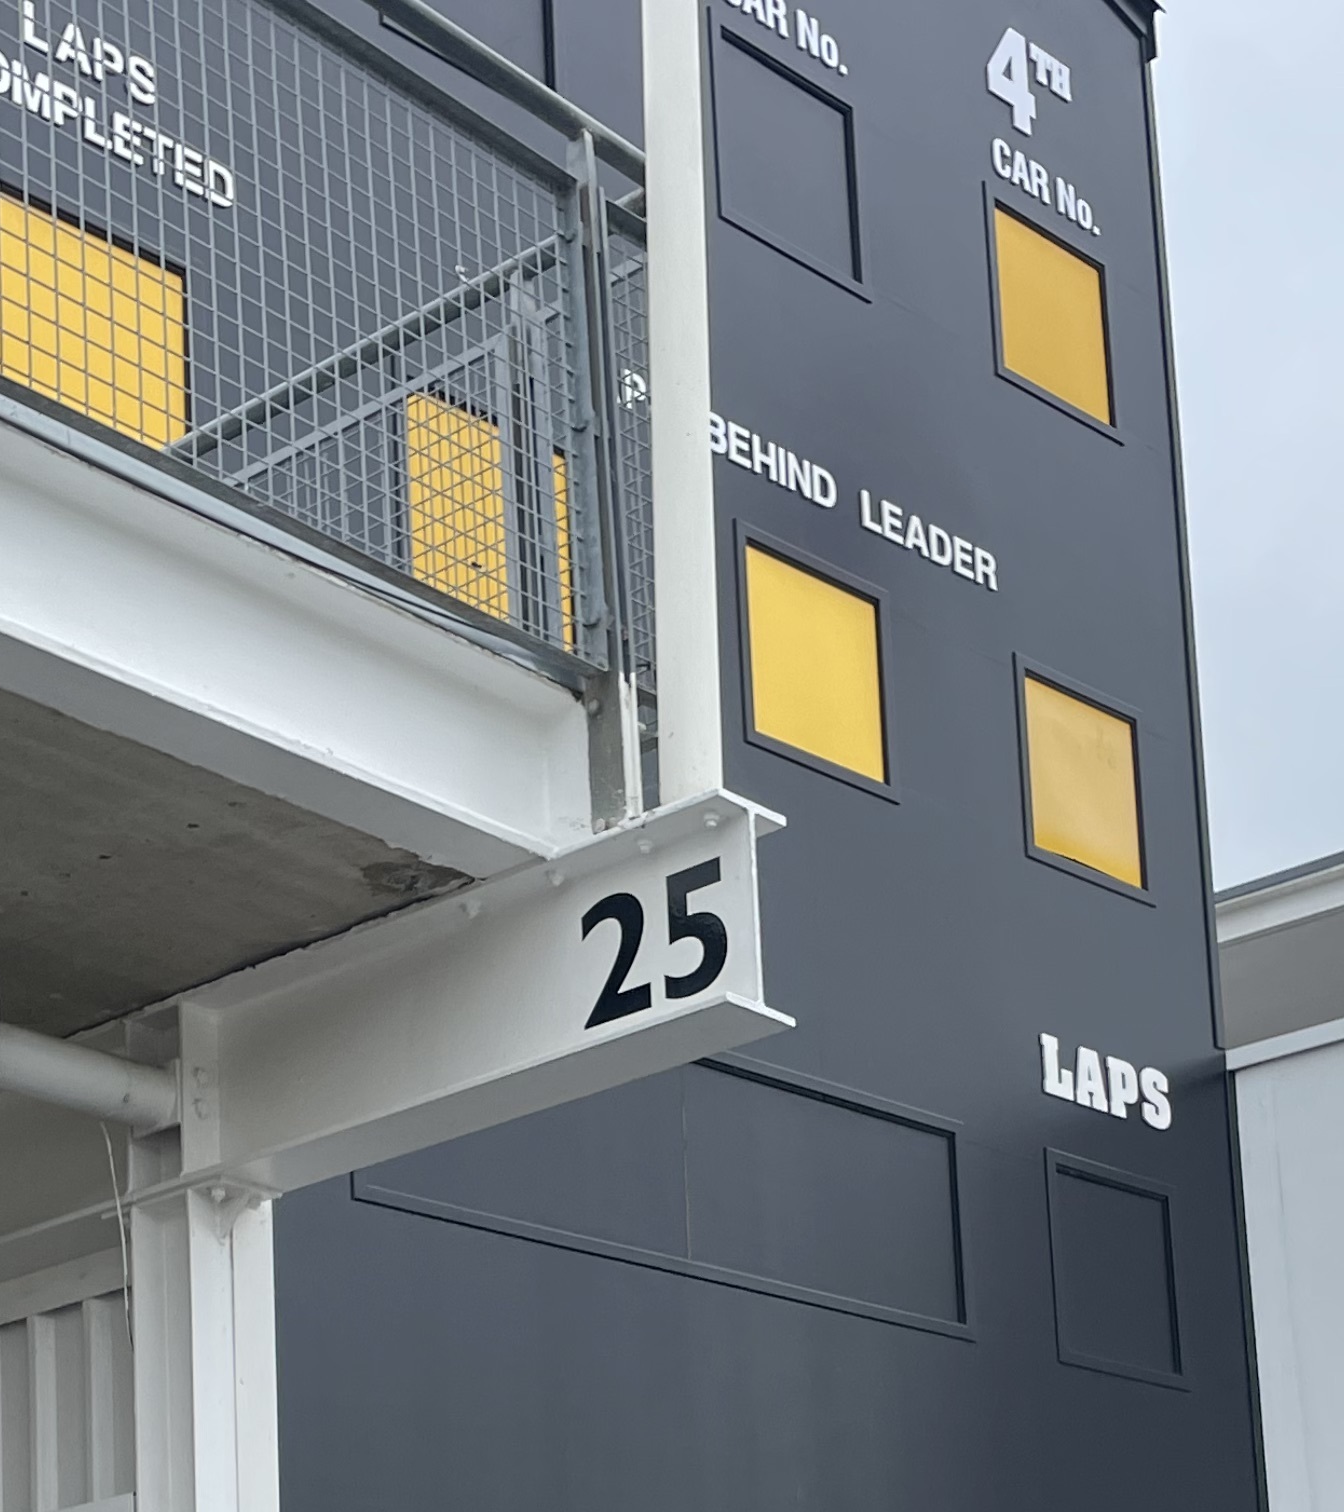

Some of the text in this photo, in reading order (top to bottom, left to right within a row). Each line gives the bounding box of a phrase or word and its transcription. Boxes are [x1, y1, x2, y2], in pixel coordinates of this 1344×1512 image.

[23, 0, 156, 105] LAPS
[796, 8, 848, 75] No.
[987, 27, 1072, 136] 4TH
[992, 137, 1101, 236] CAR No.
[708, 411, 998, 590] BEHIND LEADER
[581, 856, 728, 1029] 25
[1039, 1032, 1172, 1130] LAPS
